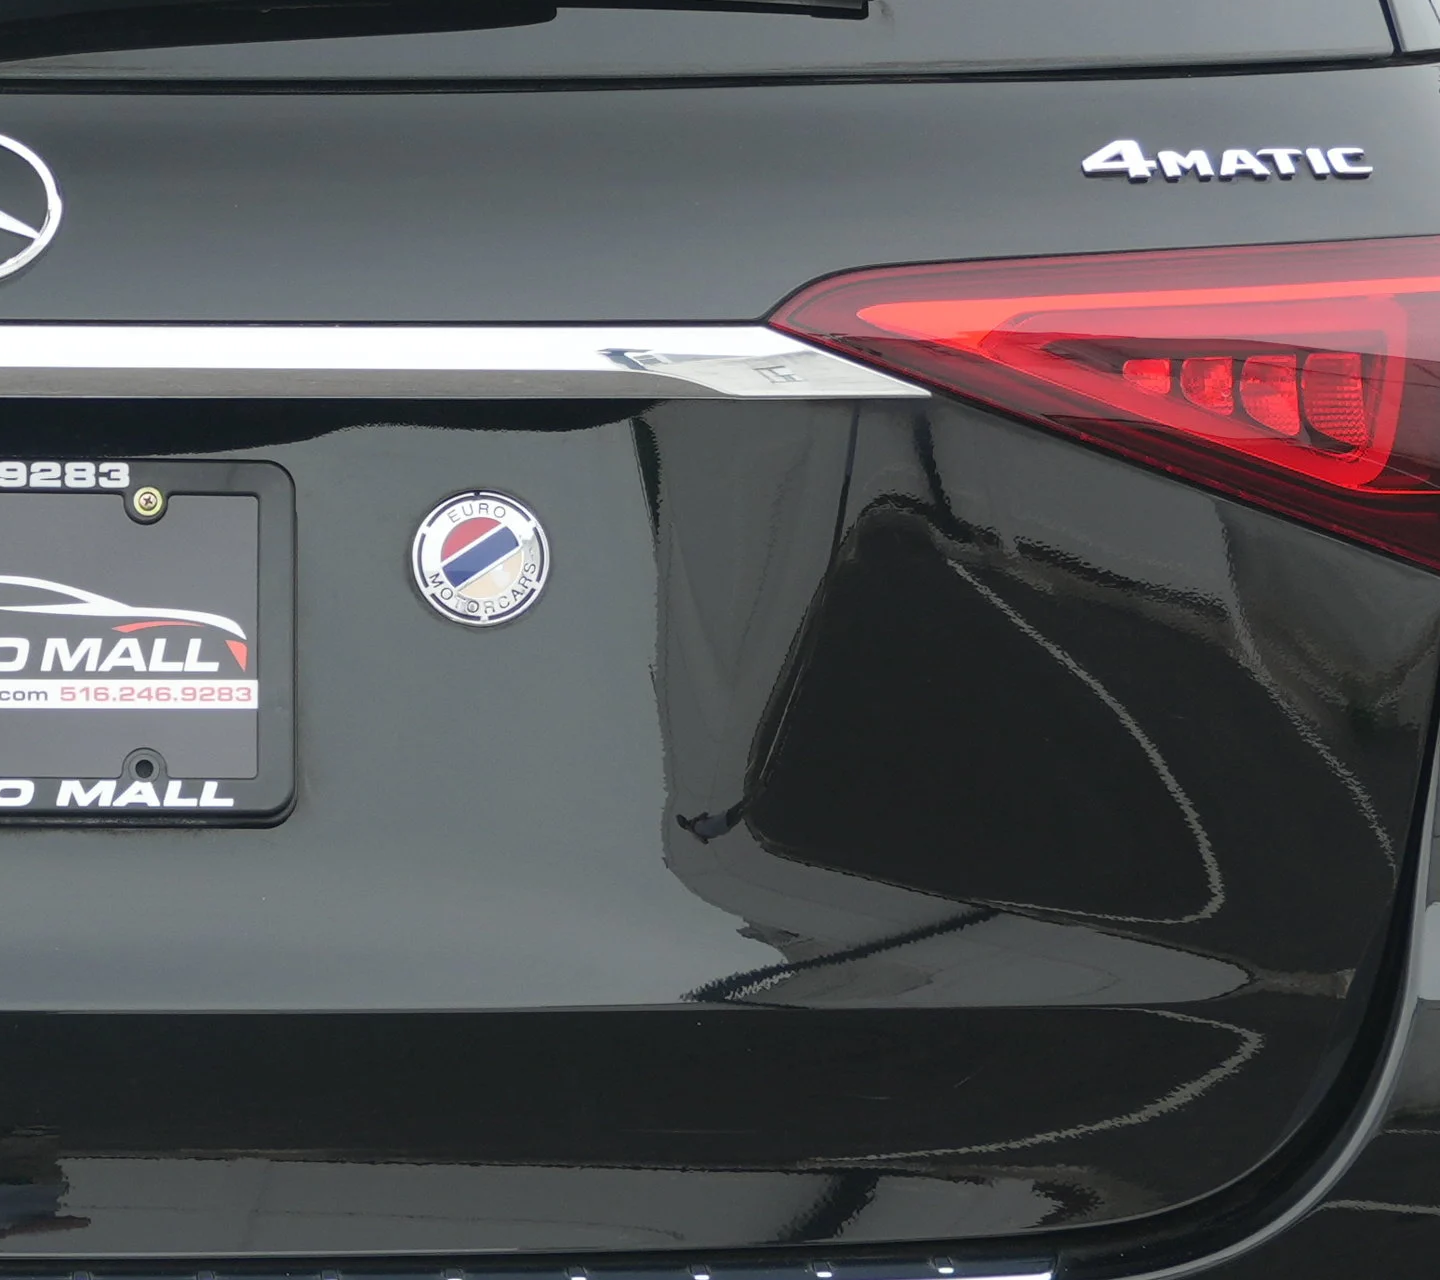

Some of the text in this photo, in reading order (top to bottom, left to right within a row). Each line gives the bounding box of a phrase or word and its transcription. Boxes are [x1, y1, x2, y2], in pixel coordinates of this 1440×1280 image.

[1081, 139, 1373, 183] 4MATIC
[447, 502, 506, 523] EURO
[428, 562, 537, 615] MOTORCARS
[41, 639, 220, 673] MALL
[59, 686, 252, 702] 516.246.9283
[54, 780, 234, 808] MALL
